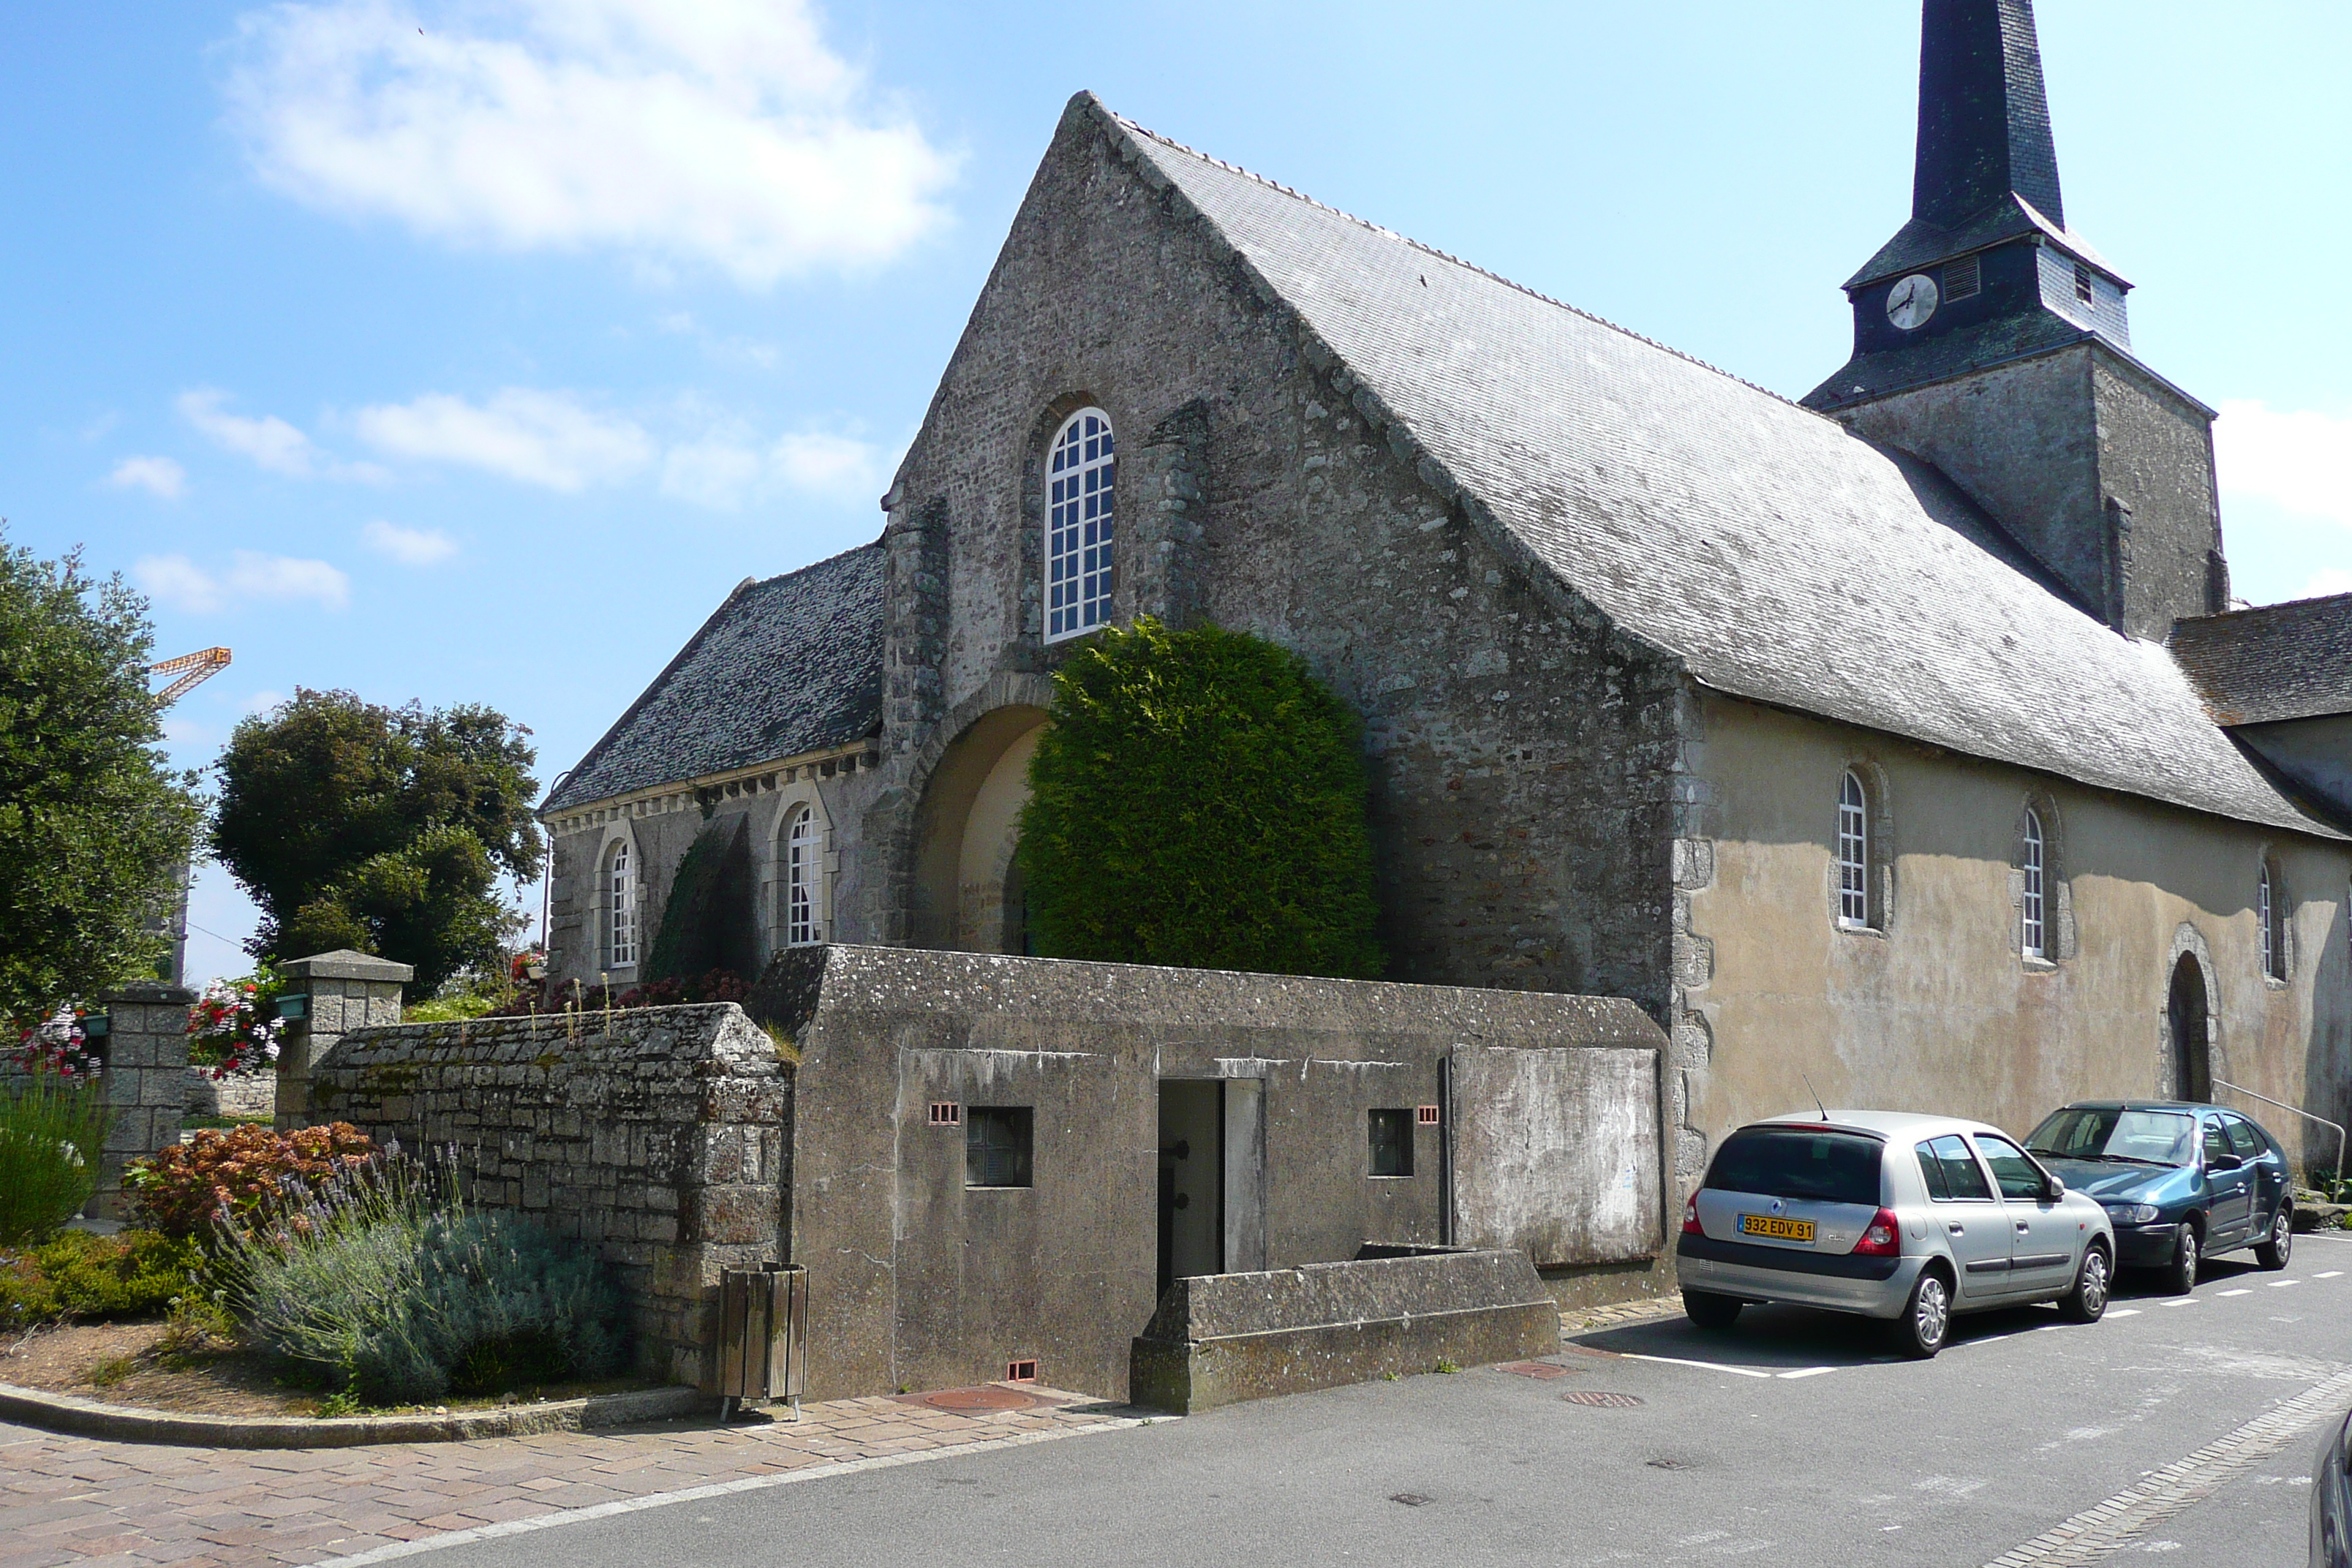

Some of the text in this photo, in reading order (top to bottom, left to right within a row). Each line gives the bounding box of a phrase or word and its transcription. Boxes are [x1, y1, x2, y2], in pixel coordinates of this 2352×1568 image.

[1745, 1218, 1767, 1232] 932
[1771, 1221, 1793, 1235] EDV
[1797, 1224, 1812, 1237] 91
